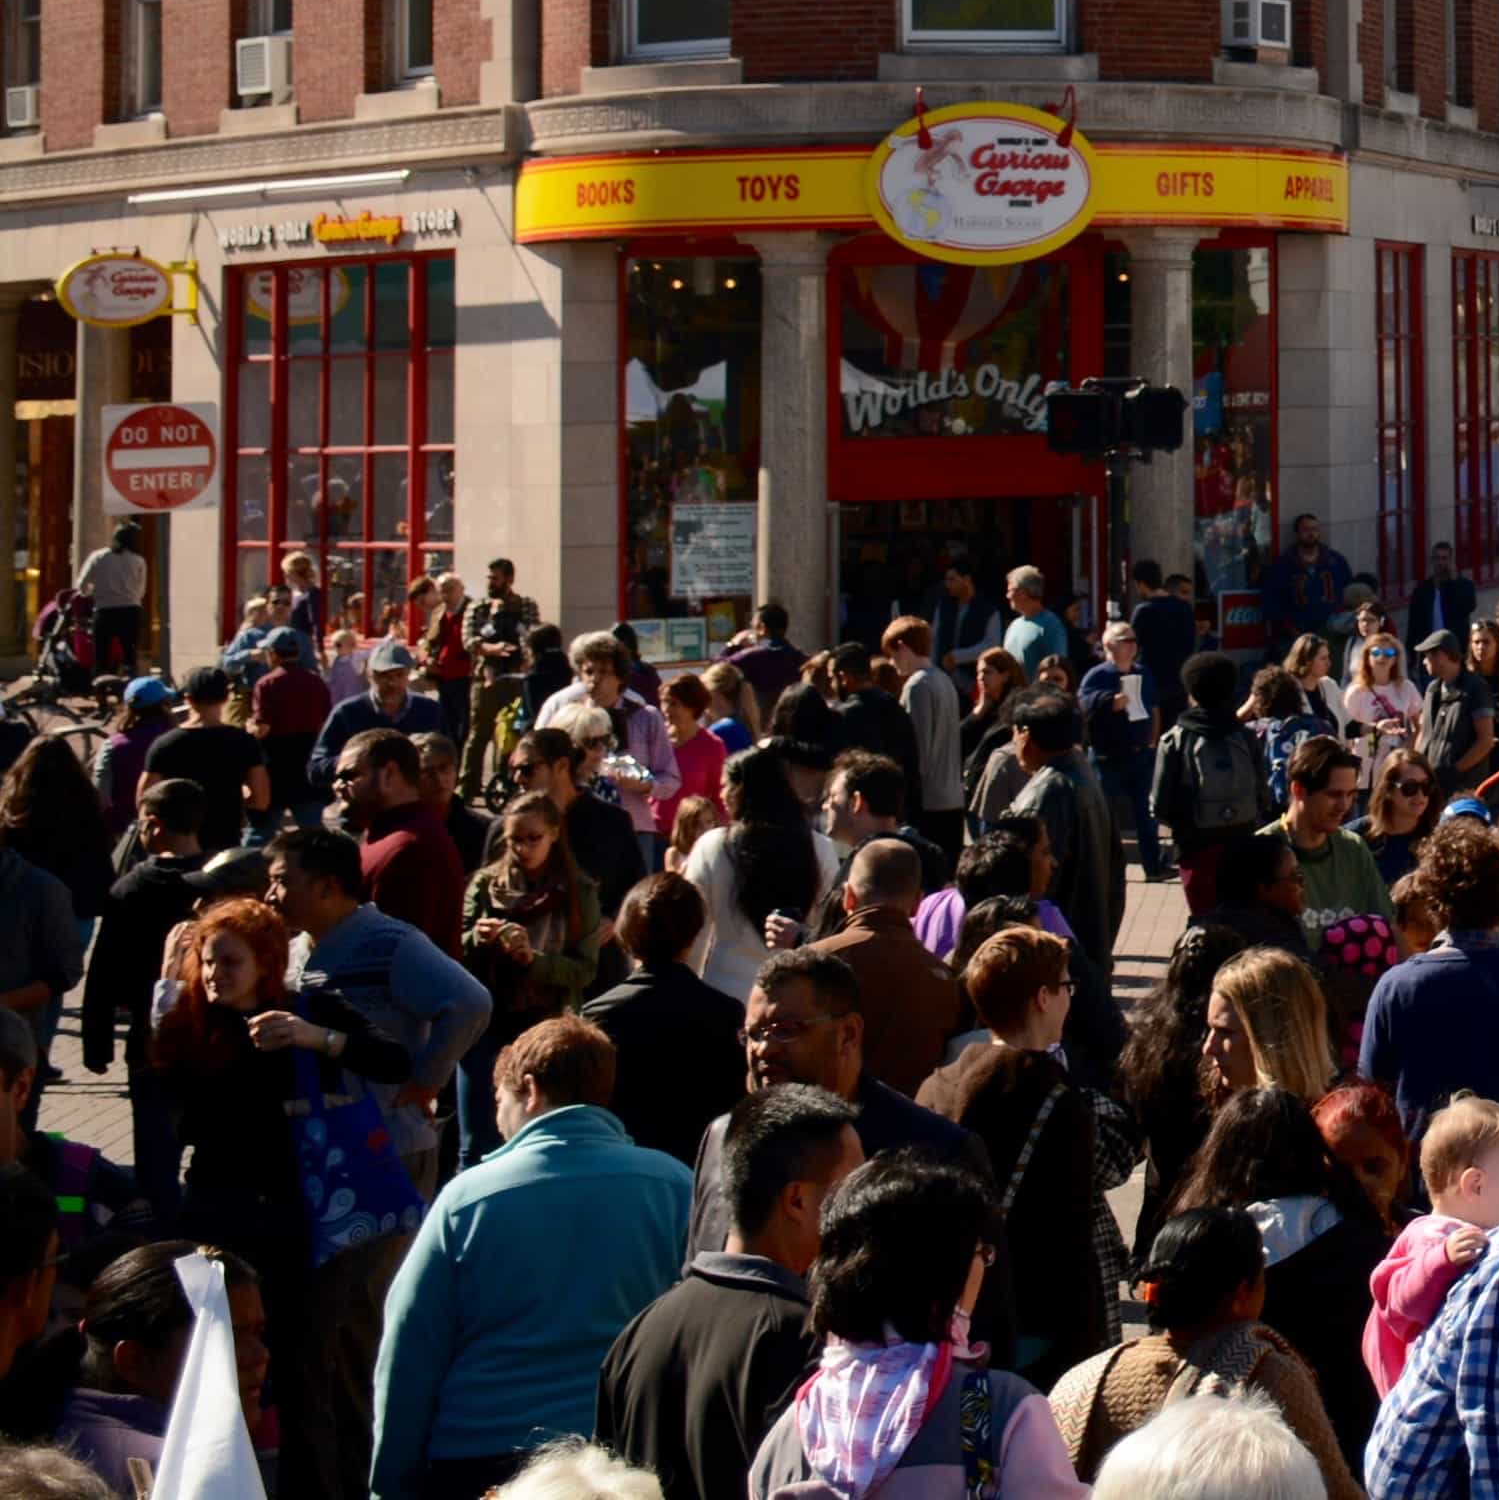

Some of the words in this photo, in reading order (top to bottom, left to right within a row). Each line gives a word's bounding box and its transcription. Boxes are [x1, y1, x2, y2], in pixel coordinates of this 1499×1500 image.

[970, 143, 1071, 170] Curious
[576, 179, 636, 208] BOOKS
[736, 174, 801, 202] TOYS
[1156, 172, 1215, 197] GIFTS
[1284, 176, 1335, 203] APPAREL
[974, 171, 1066, 204] George
[217, 226, 273, 248] WORLD'S
[844, 367, 969, 432] World's
[975, 364, 1048, 430] Only
[120, 427, 148, 445] DO
[160, 424, 200, 442] NOT
[129, 471, 194, 491] ENTER
